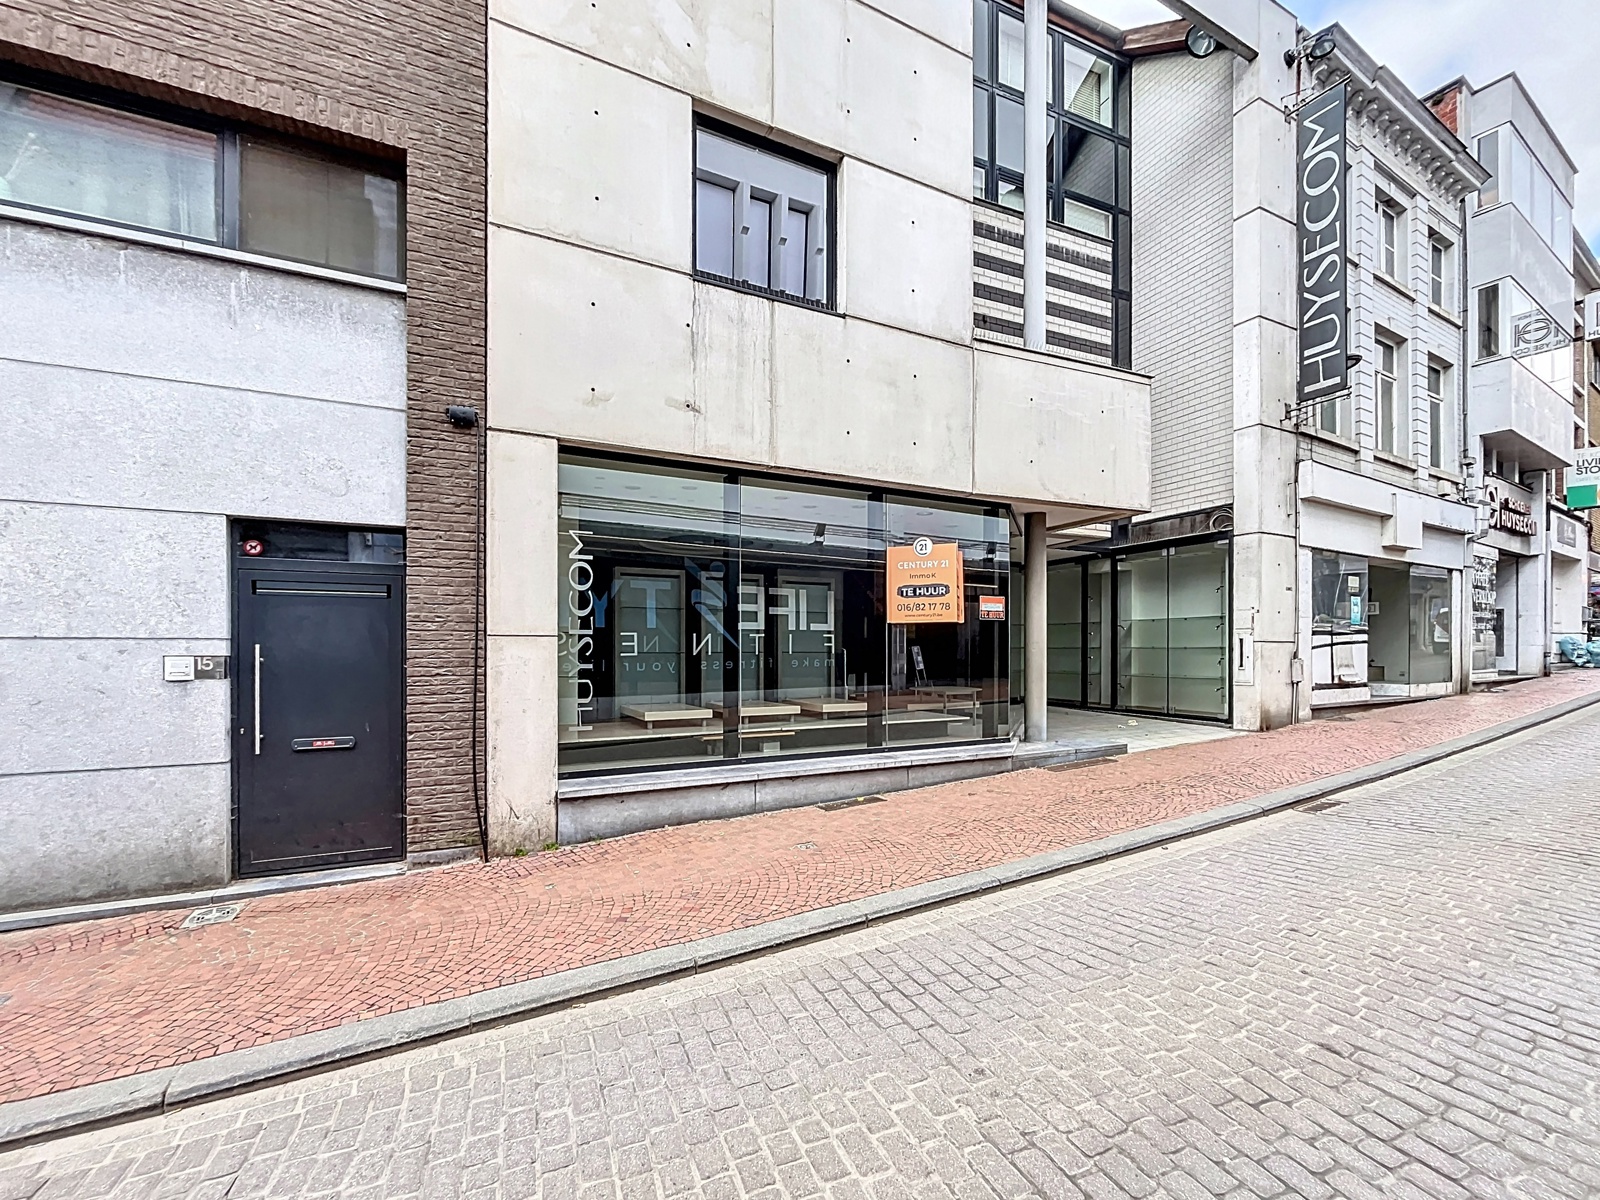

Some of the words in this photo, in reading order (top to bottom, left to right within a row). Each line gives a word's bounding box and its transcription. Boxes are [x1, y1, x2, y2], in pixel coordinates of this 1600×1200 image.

[1302, 99, 1342, 394] HUYSECOM
[897, 560, 939, 570] CENTURY
[940, 559, 949, 568] 21
[901, 587, 914, 597] TE
[916, 586, 947, 596] HUUR
[896, 602, 926, 612] 016/82
[928, 602, 938, 611] 17
[939, 602, 951, 611] 78
[568, 529, 594, 731] HUYSECOM
[194, 656, 214, 671] 15
